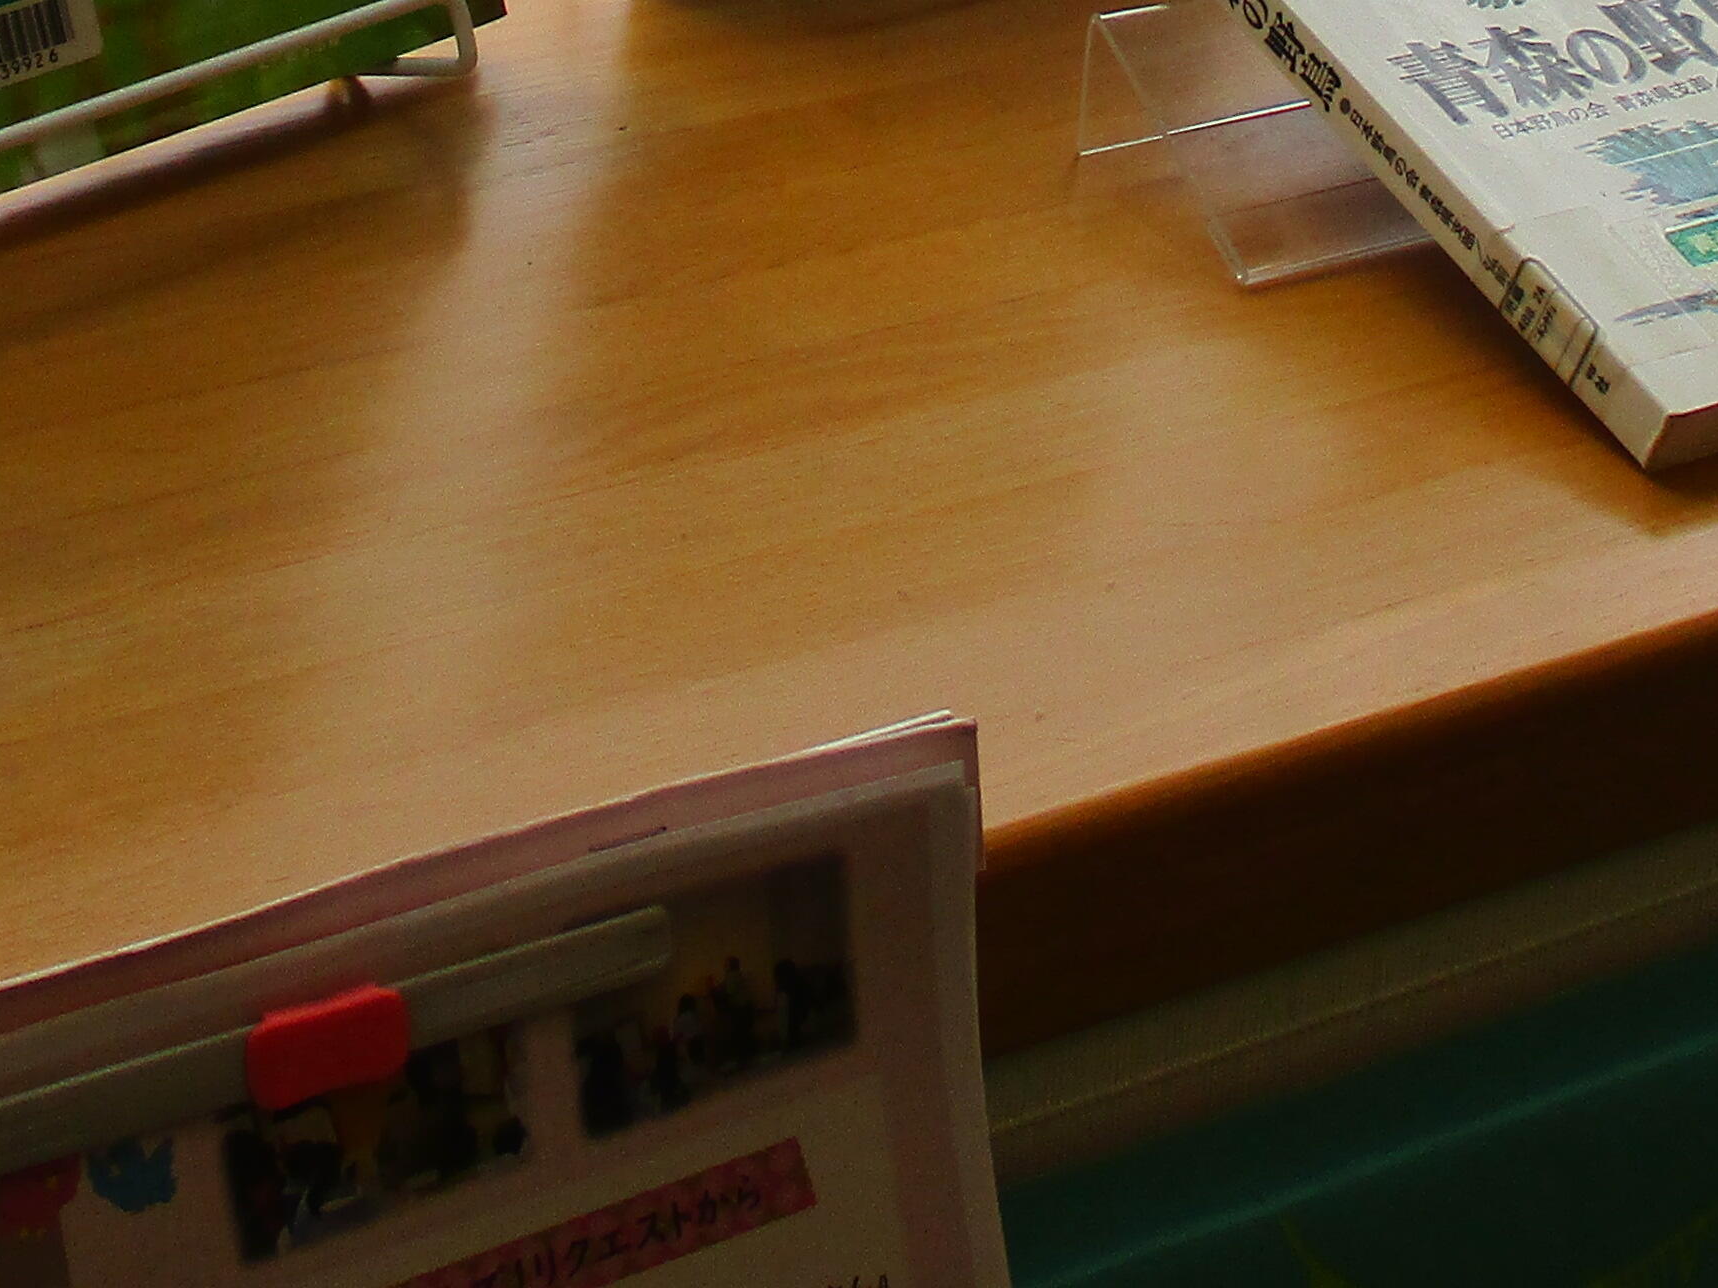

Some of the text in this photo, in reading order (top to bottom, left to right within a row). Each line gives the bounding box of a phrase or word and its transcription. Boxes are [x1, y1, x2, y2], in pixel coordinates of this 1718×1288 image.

[1491, 100, 1611, 141] 日本野鳥の会
